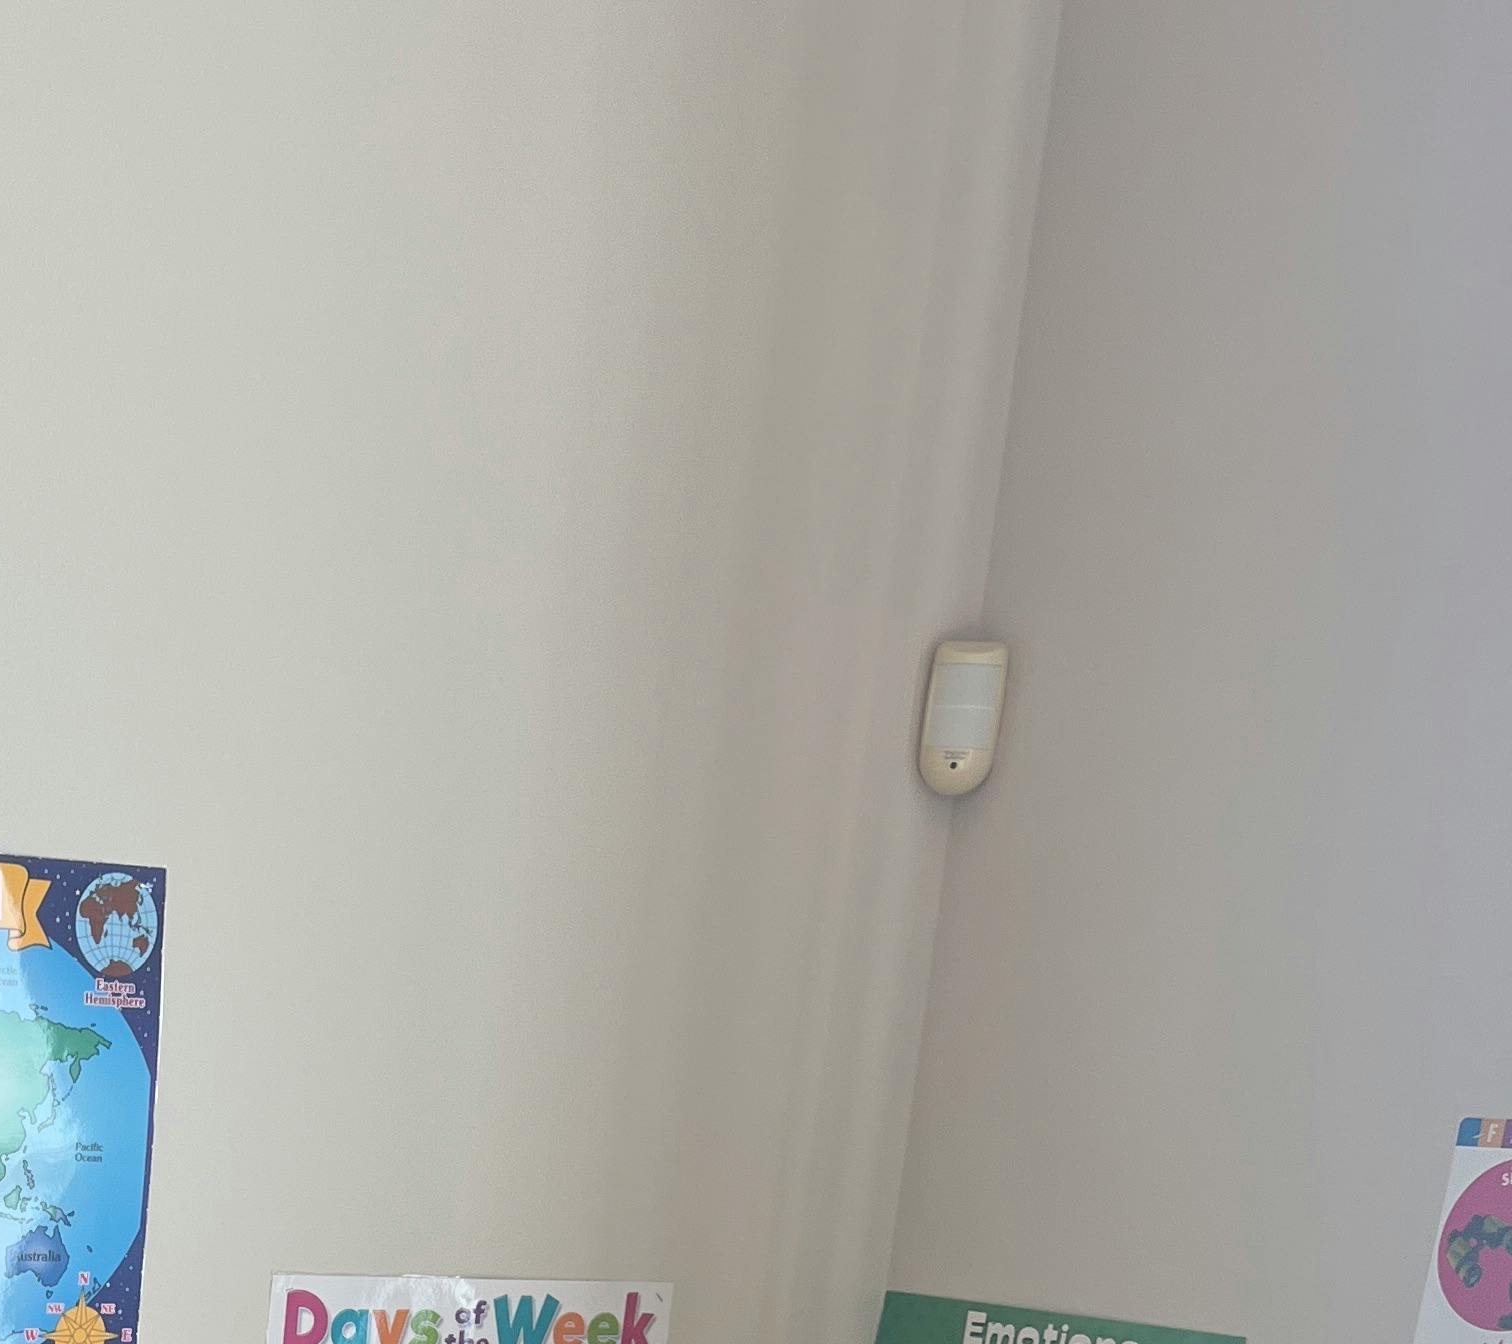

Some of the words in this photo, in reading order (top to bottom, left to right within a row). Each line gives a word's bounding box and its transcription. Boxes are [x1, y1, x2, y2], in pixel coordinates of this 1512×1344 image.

[96, 979, 136, 995] Eastern
[84, 992, 146, 1008] Hemisphere
[75, 1141, 104, 1153] Pacific
[74, 1152, 103, 1163] Ocean
[80, 1274, 89, 1284] N
[103, 1303, 116, 1314] NE
[455, 1300, 488, 1326] of
[24, 1330, 37, 1341] W
[122, 1329, 132, 1342] E
